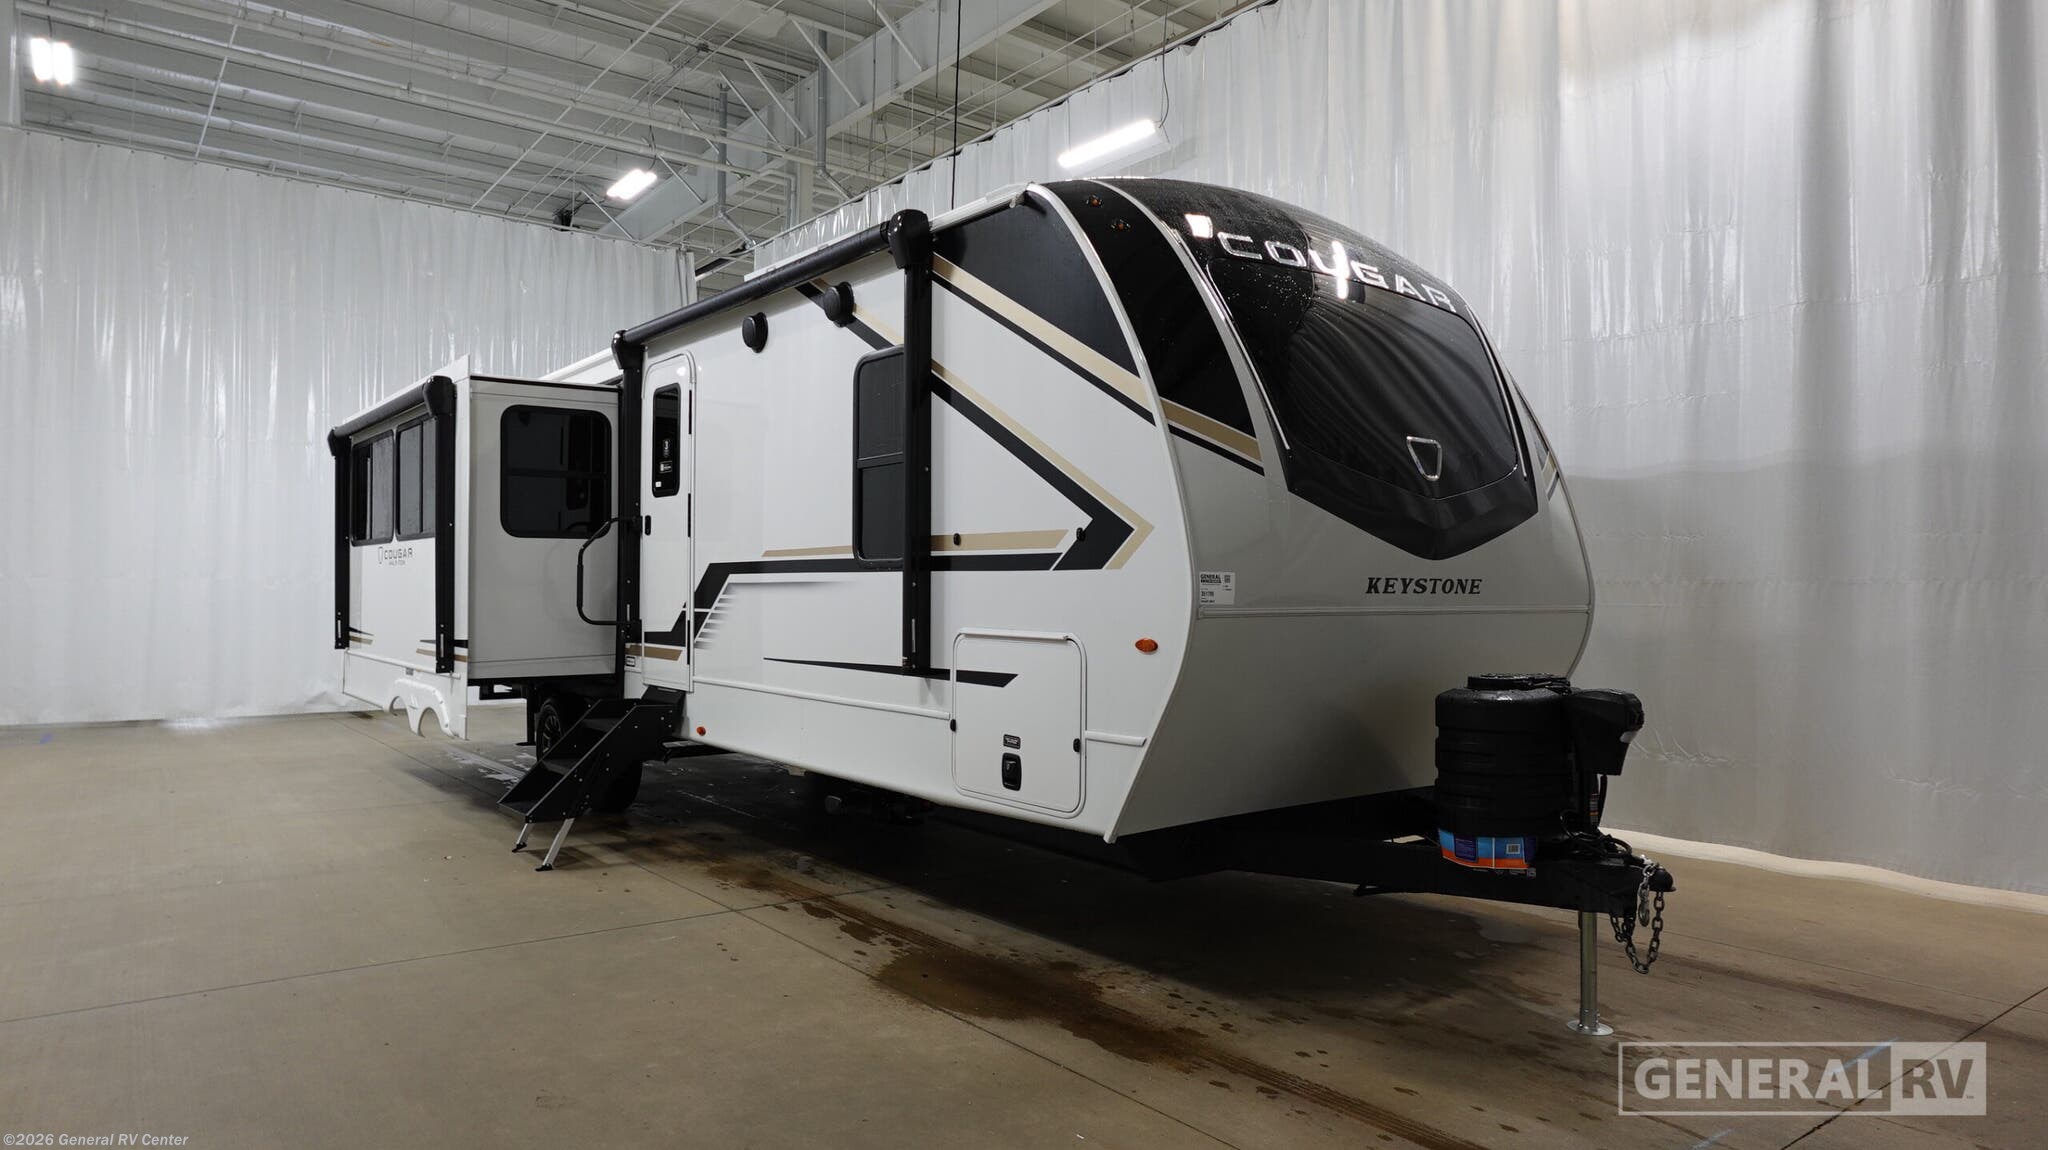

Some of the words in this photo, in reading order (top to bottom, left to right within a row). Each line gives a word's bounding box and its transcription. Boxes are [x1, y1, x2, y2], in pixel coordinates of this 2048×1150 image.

[1216, 231, 1457, 312] COUGAR
[384, 547, 413, 560] COUGAR
[1366, 577, 1482, 595] KEYSTONE
